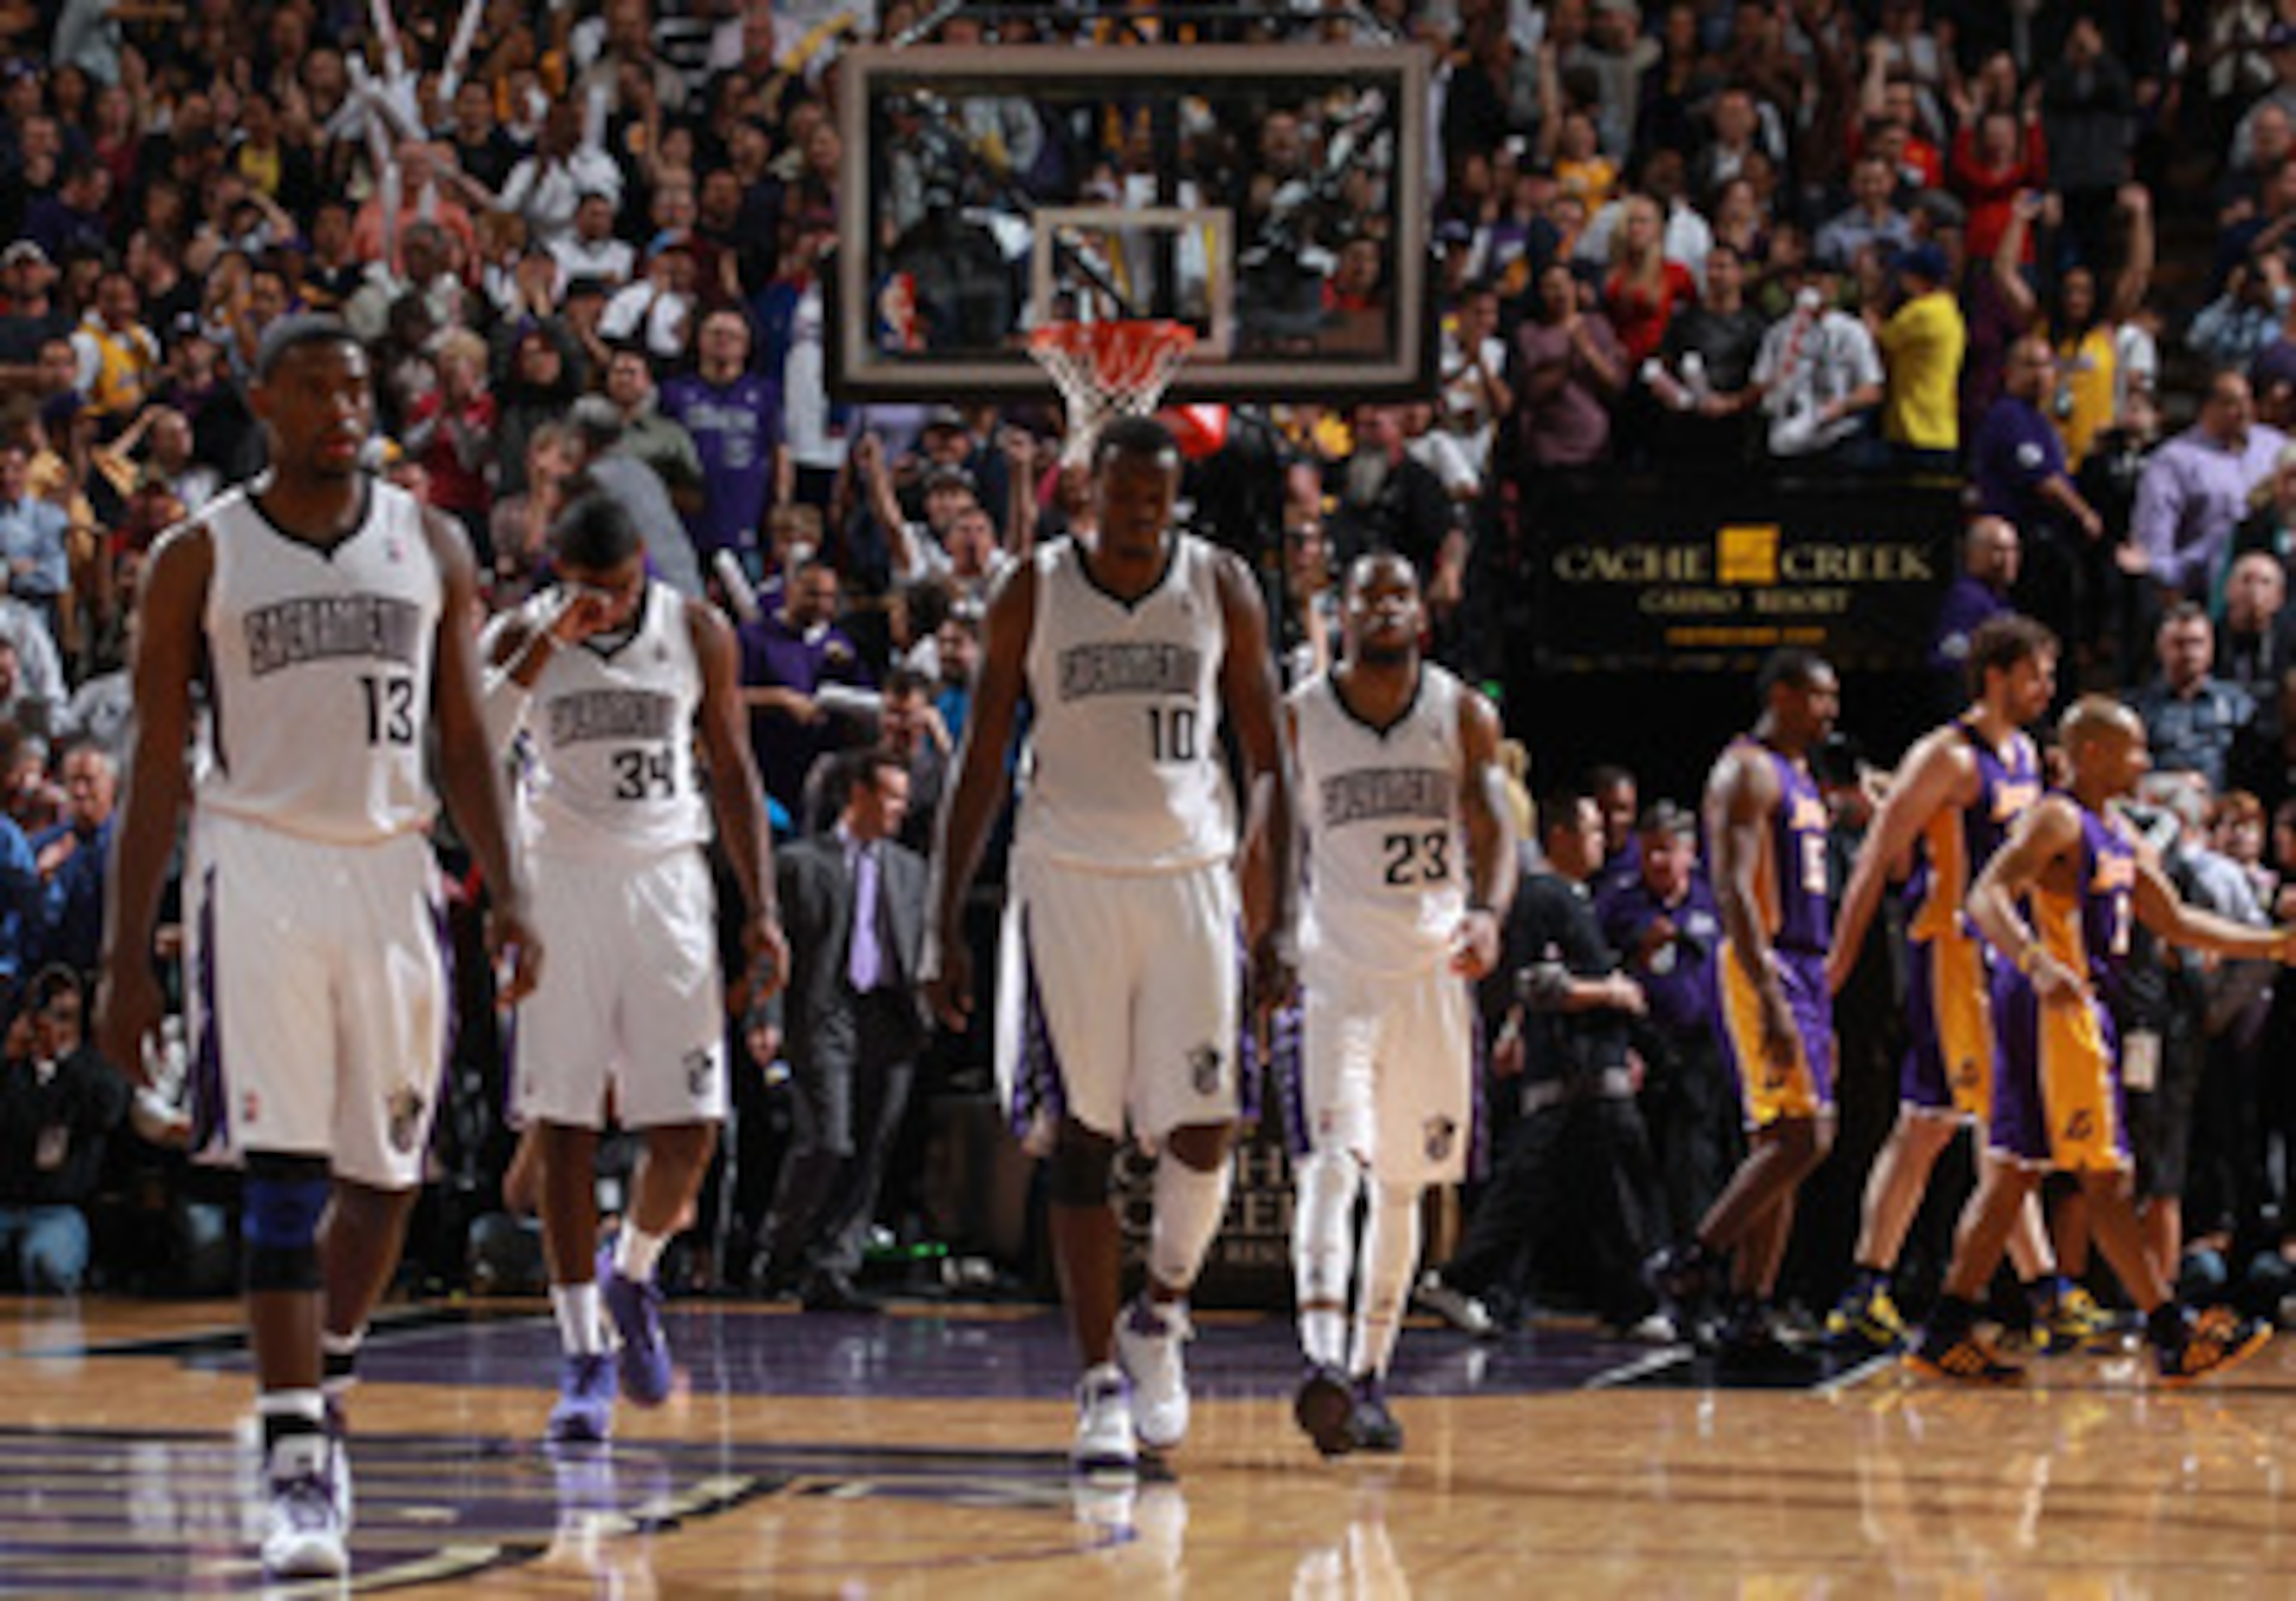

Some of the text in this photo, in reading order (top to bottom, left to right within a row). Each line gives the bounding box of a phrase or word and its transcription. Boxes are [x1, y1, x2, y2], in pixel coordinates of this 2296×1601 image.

[1553, 543, 1934, 581] CACHE CREEK
[358, 676, 414, 744] 13
[1148, 708, 1196, 761] 10
[613, 746, 676, 800] 34
[1383, 830, 1449, 885] 23
